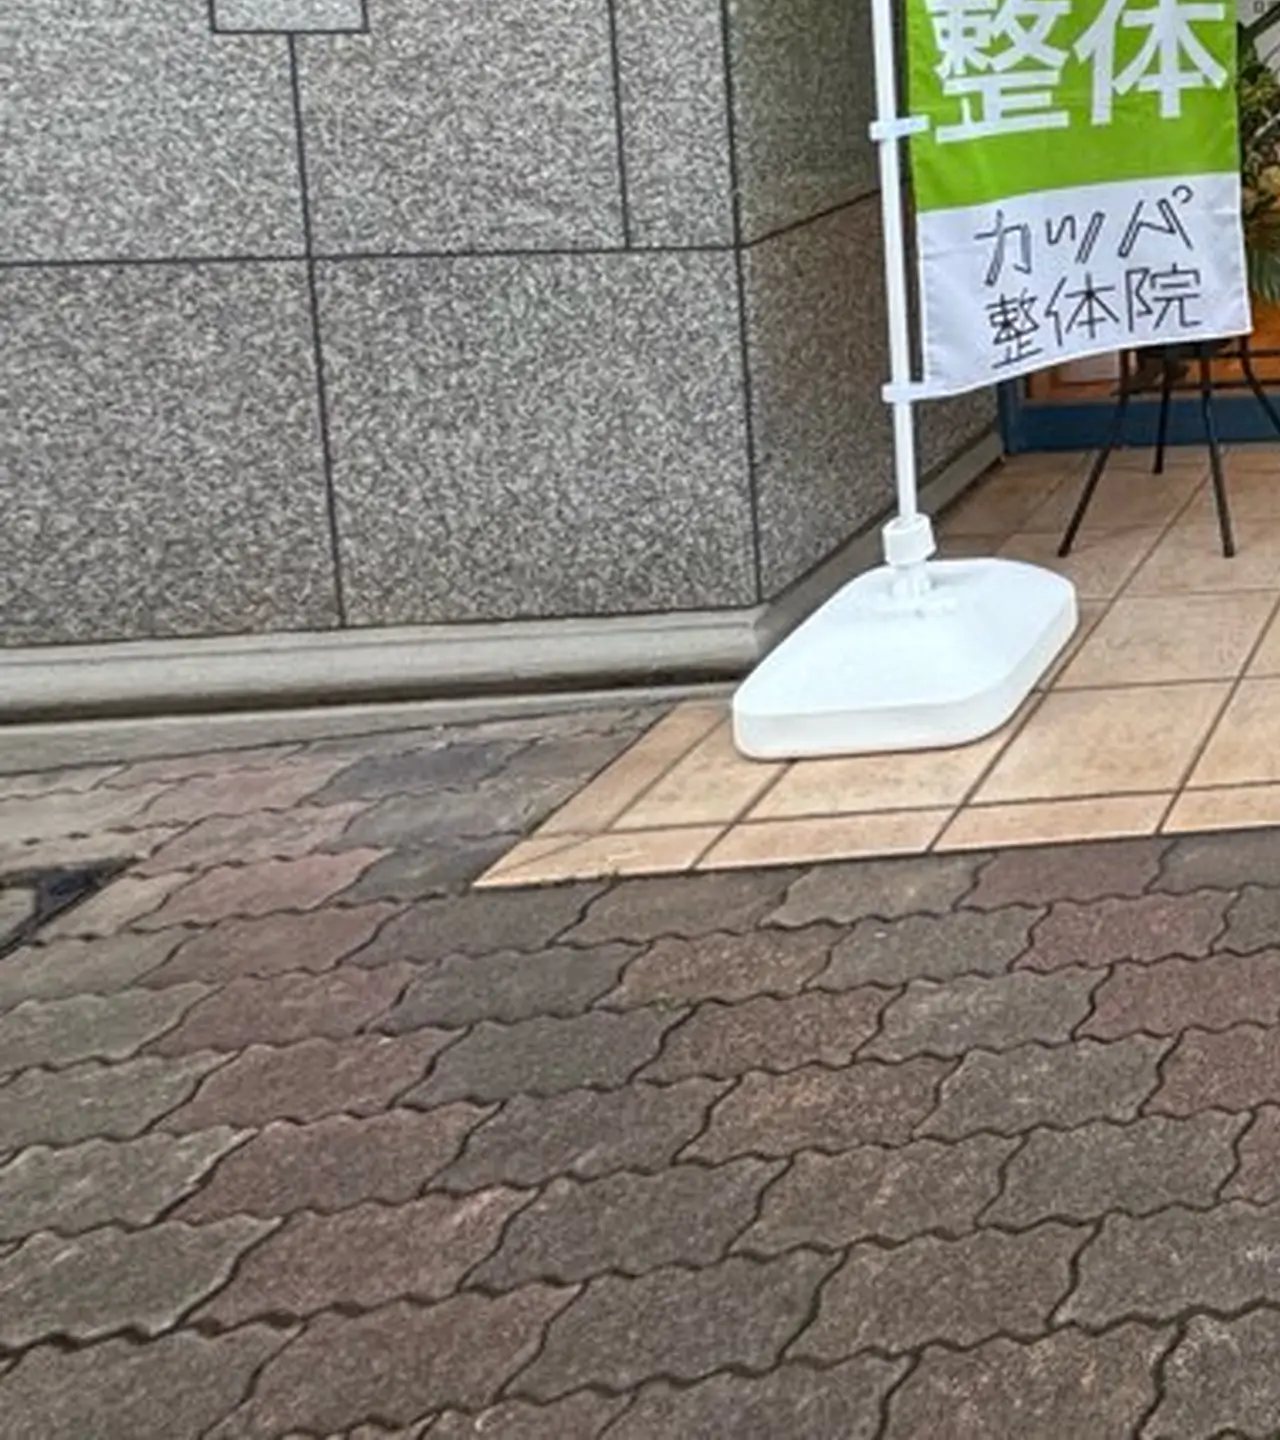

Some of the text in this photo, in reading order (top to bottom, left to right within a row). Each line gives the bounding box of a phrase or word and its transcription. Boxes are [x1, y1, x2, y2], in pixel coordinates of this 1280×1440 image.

[975, 184, 1194, 287] カッパ
[986, 262, 1201, 370] 整体院
